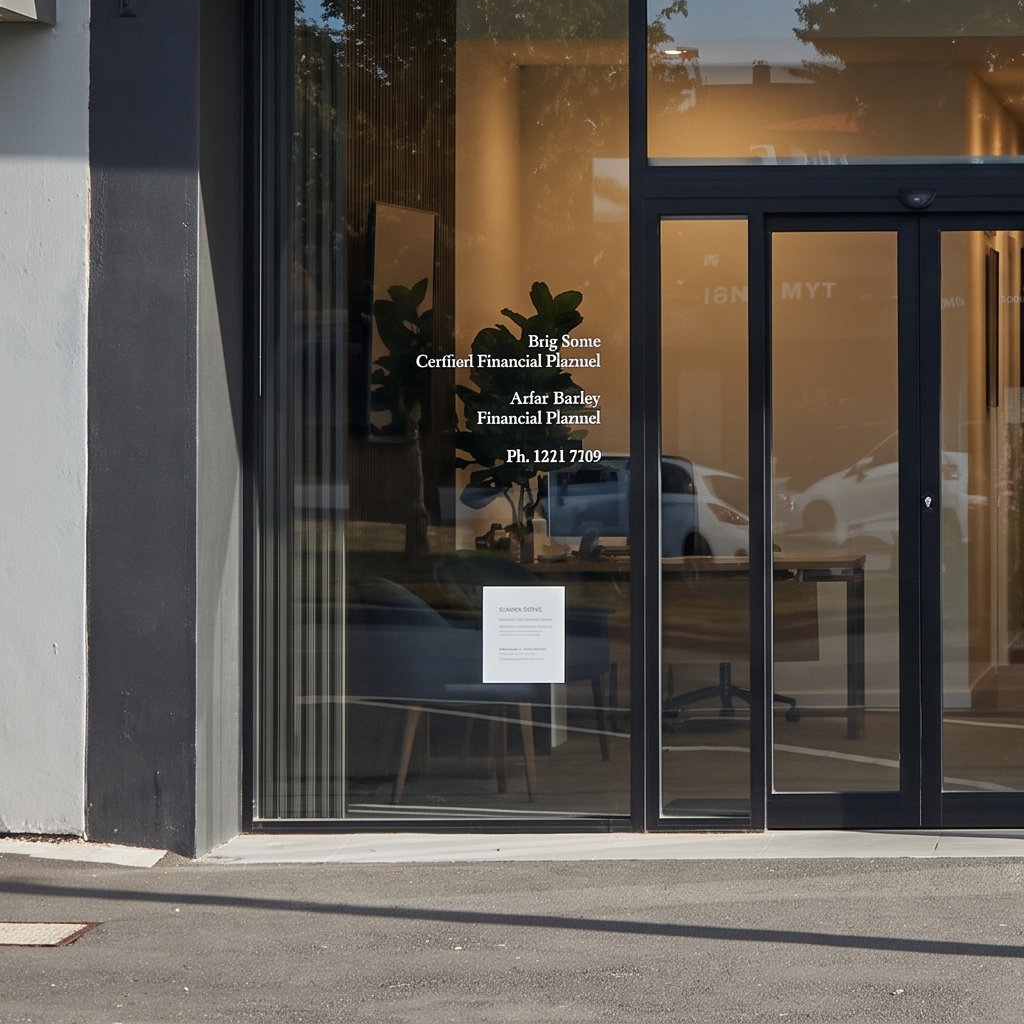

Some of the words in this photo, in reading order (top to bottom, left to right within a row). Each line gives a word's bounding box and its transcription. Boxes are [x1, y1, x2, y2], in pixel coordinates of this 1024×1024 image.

[527, 334, 558, 352] Brig
[561, 334, 602, 348] Some
[477, 353, 543, 368] Financial
[553, 390, 602, 408] Barley
[477, 410, 543, 425] Financial
[506, 449, 530, 463] Ph.
[533, 449, 566, 463] 1221
